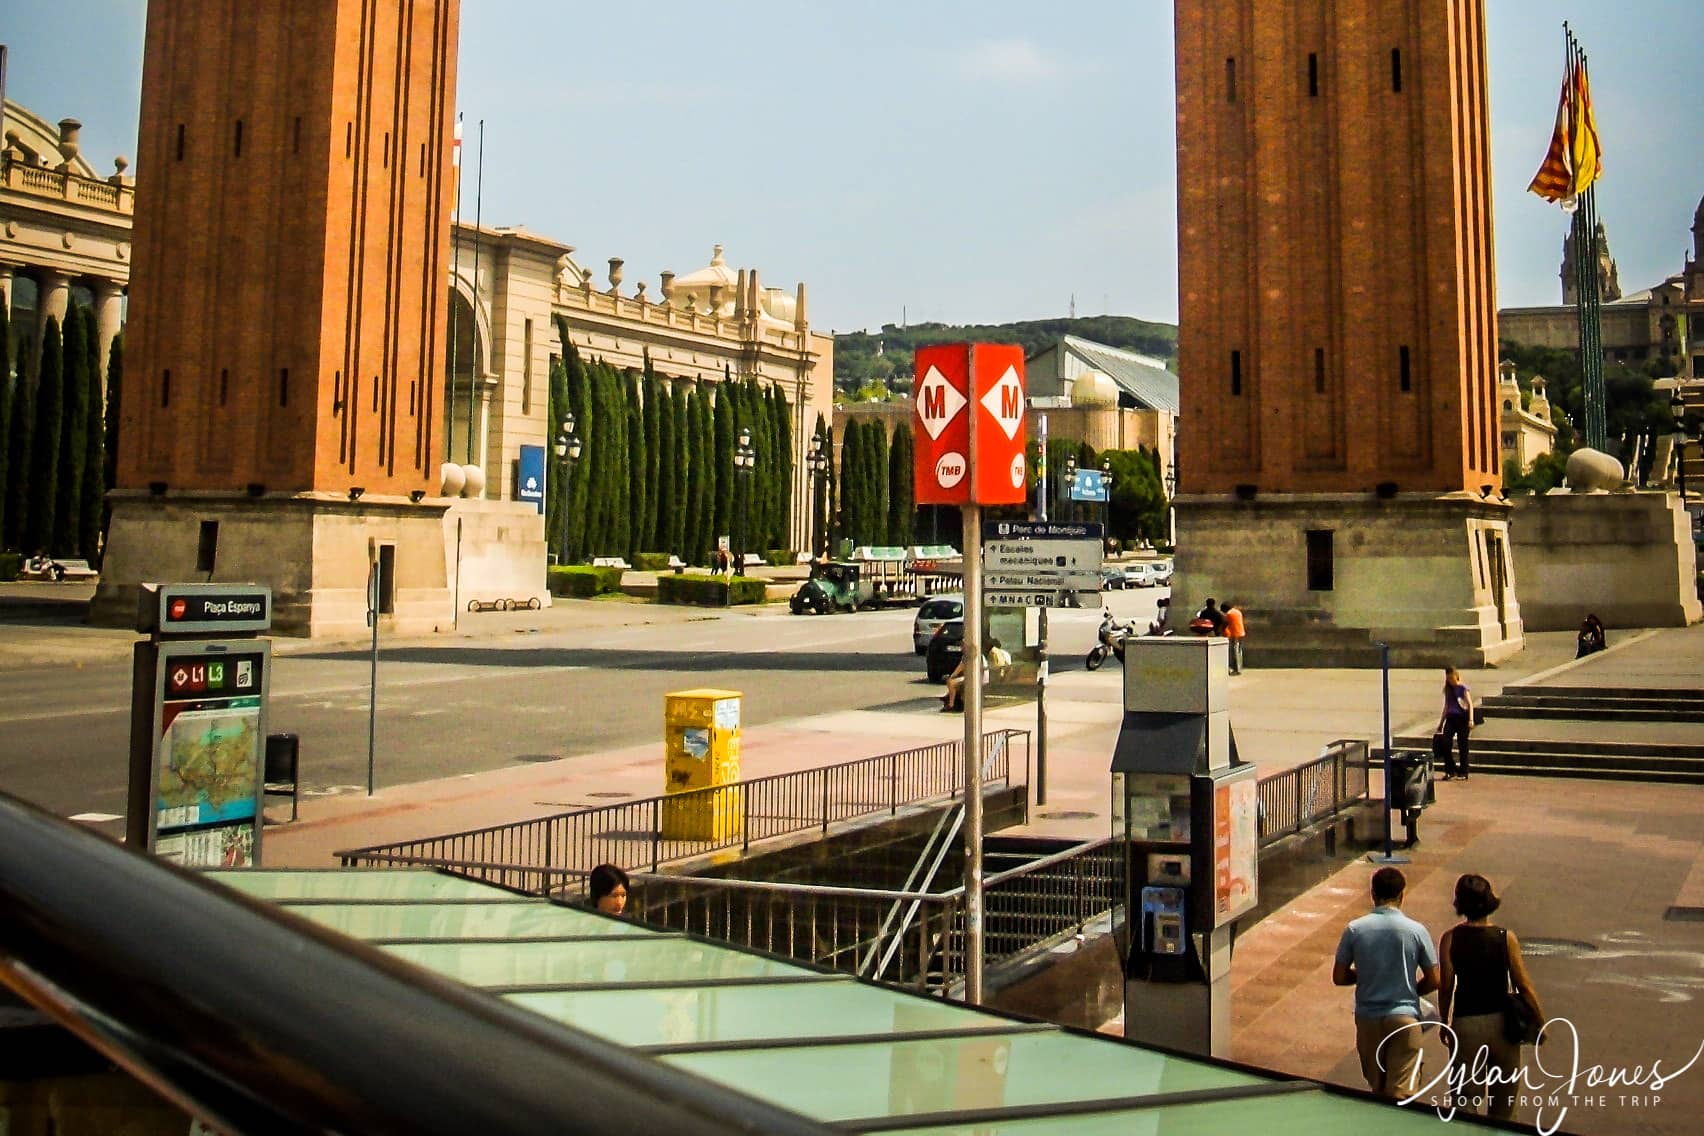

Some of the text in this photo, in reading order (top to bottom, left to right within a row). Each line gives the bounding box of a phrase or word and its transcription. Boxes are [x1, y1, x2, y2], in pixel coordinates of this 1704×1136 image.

[924, 385, 946, 419] M
[1001, 385, 1019, 419] M
[941, 465, 961, 476] TMB
[1012, 524, 1033, 535] Parc
[204, 601, 260, 615] Plaça Espanya
[192, 666, 204, 683] L1
[208, 666, 223, 682] L3
